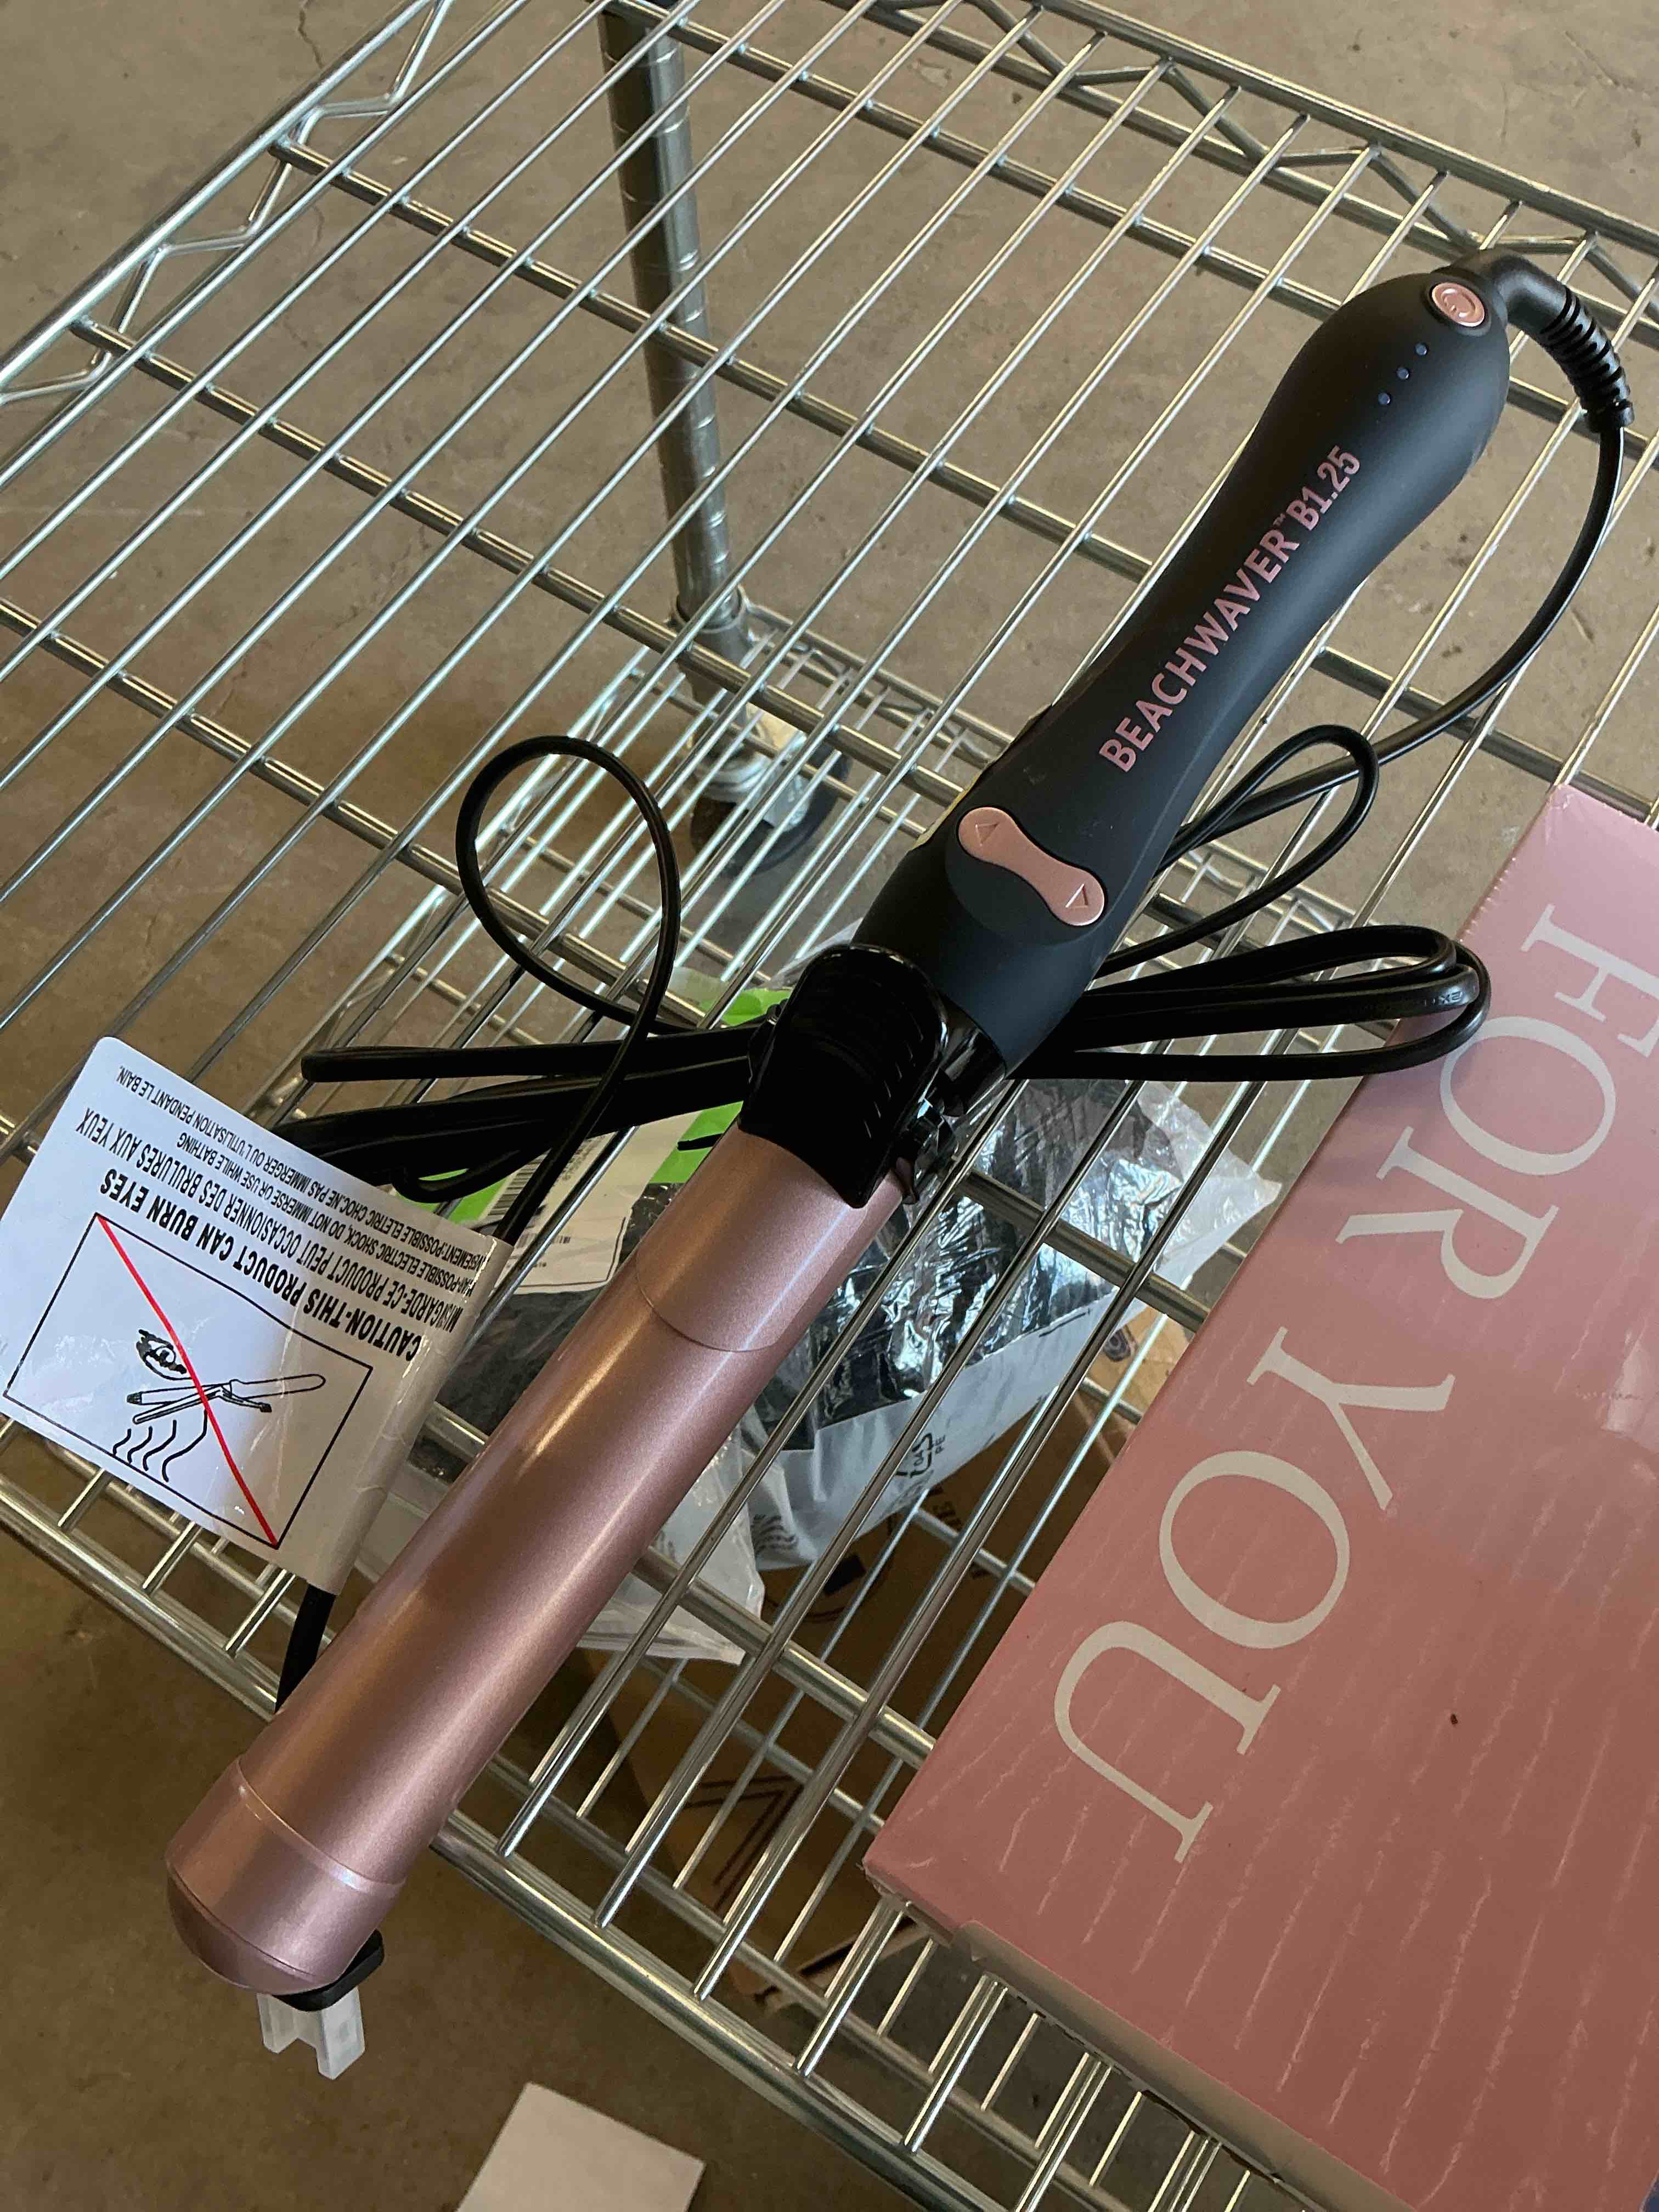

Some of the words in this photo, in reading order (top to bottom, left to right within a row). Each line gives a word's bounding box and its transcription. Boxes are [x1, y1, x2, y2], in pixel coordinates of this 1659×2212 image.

[1286, 445, 1360, 531] B1.25
[138, 1080, 155, 1101] LE
[150, 1089, 196, 1125] PENDANT
[1335, 904, 1659, 1299] FOR
[75, 1108, 114, 1148] YEUX
[109, 1127, 143, 1162] AUX
[192, 1113, 253, 1160] L'UTILISATION
[177, 1132, 218, 1166] BATHING
[249, 1148, 266, 1167] OU
[136, 1143, 204, 1198] BRULURES
[214, 1154, 244, 1183] WHILE
[240, 1170, 261, 1194] USE
[263, 1155, 312, 1193] IMMERGER
[100, 1169, 150, 1213] EYES
[199, 1180, 228, 1212] DES
[258, 1181, 274, 1200] OR
[270, 1189, 313, 1223] IMMERSE
[307, 1181, 331, 1203] PAS
[145, 1195, 199, 1242] BURN
[223, 1193, 302, 1259] OCCASIONNER
[307, 1211, 332, 1233] NOT
[328, 1221, 347, 1240] DO
[365, 1210, 405, 1240] ELETRIC
[195, 1222, 234, 1261] CAN
[296, 1240, 335, 1276] PEUT
[343, 1224, 379, 1256] SHOCK,
[232, 1245, 307, 1307] PRODUCT
[375, 1243, 421, 1276] ELECTRIC
[326, 1255, 390, 1302] PRODUCT
[303, 1288, 422, 1362] CAUTION-THIS
[1054, 1326, 1456, 1863] YOU
